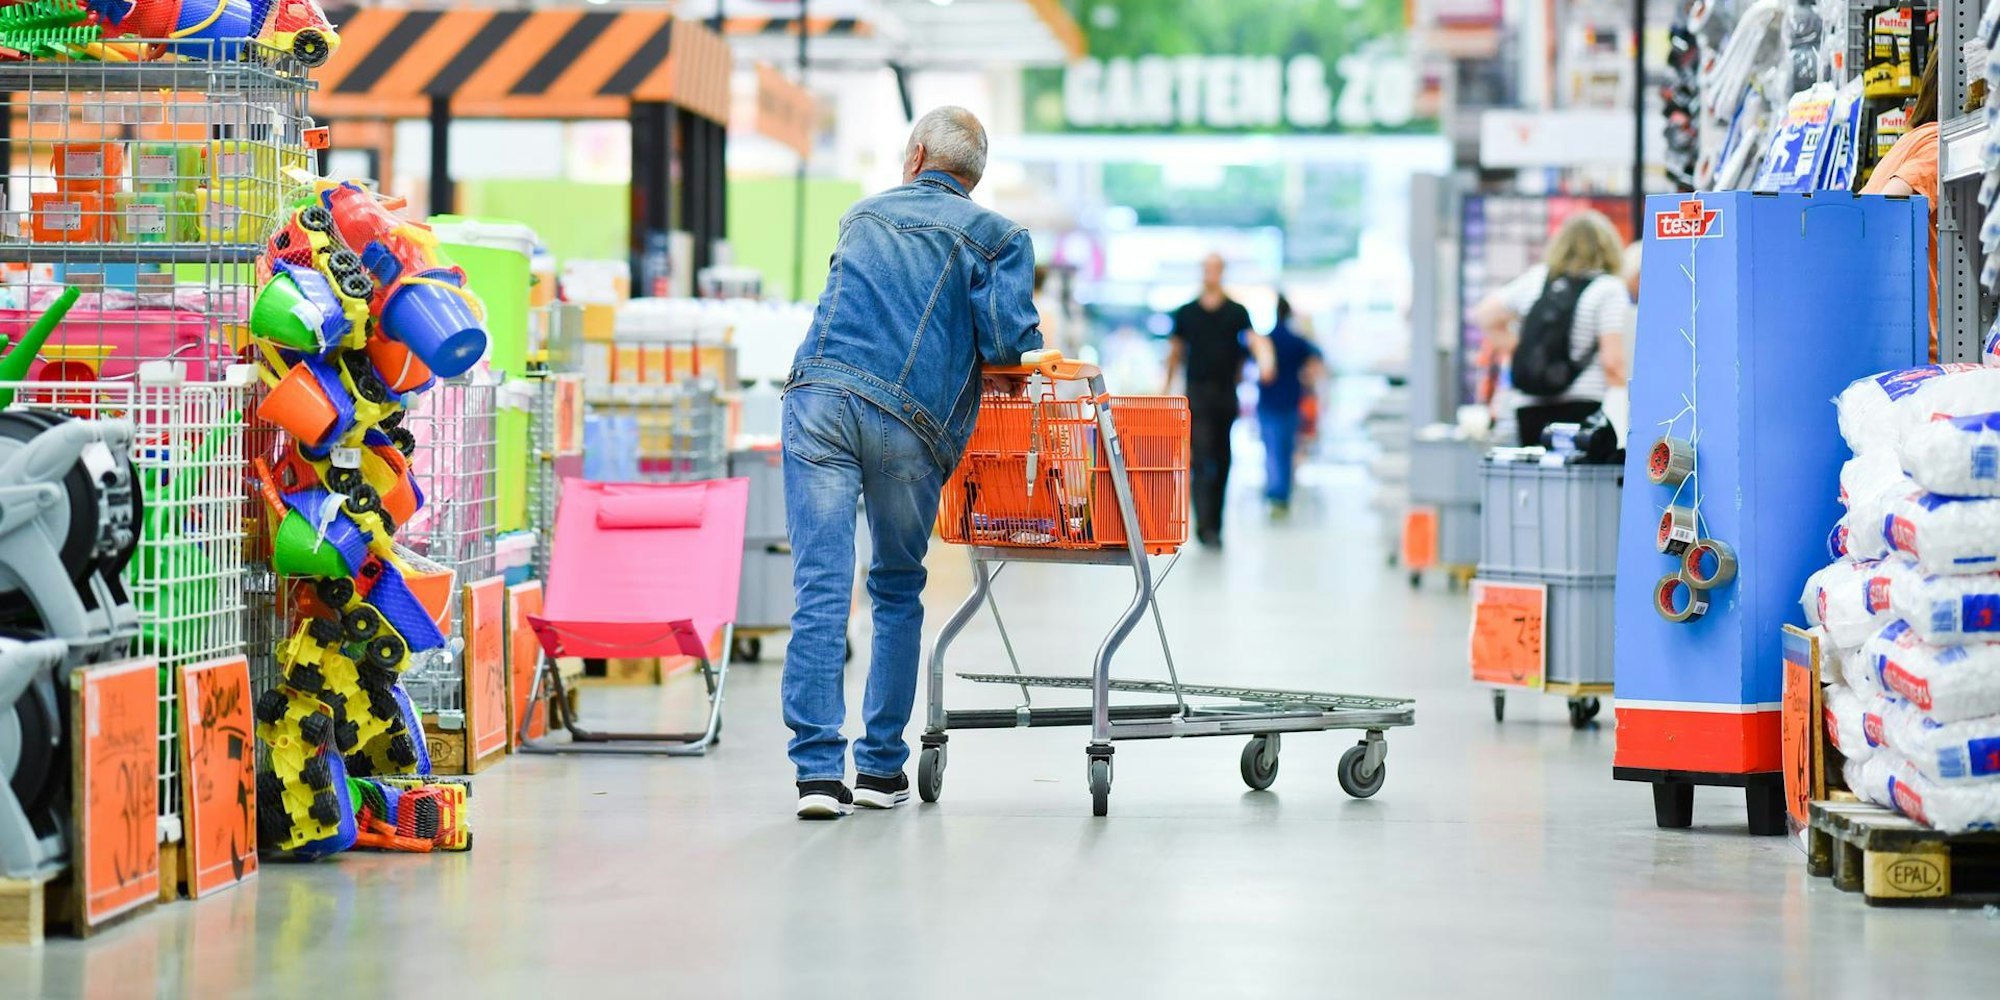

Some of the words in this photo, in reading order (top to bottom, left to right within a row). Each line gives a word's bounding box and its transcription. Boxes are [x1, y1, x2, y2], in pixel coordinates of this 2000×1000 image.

[1878, 17, 1908, 28] Pattex
[1065, 55, 1282, 127] GARTEN
[1881, 116, 1907, 127] Patte
[1660, 215, 1701, 235] tesa
[426, 741, 443, 758] UR
[1894, 866, 1932, 885] EPAL
